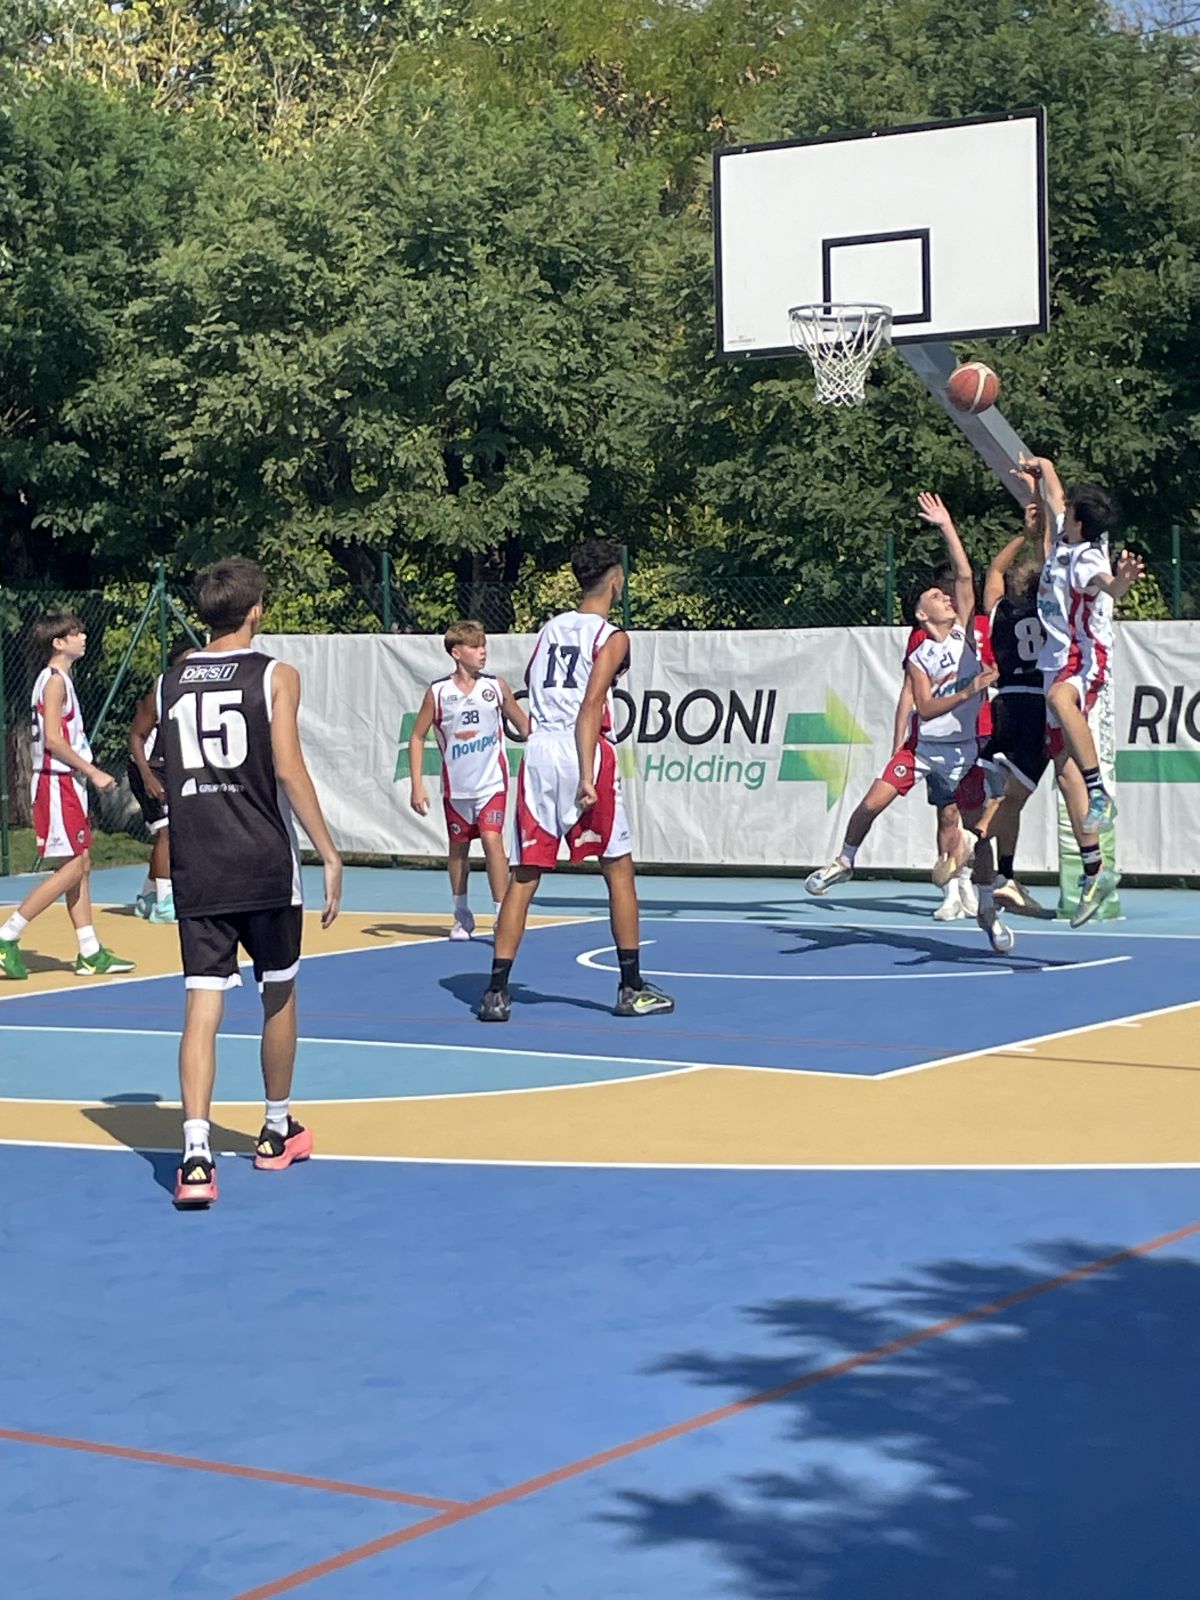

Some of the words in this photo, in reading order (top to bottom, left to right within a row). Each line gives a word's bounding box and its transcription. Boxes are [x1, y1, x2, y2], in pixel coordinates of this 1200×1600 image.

[1014, 616, 1044, 661] 8
[182, 665, 233, 680] ORSI
[543, 643, 581, 688] 17
[940, 651, 956, 669] 21
[168, 690, 248, 769] 15
[461, 709, 480, 725] 38
[644, 754, 766, 790] Holding
